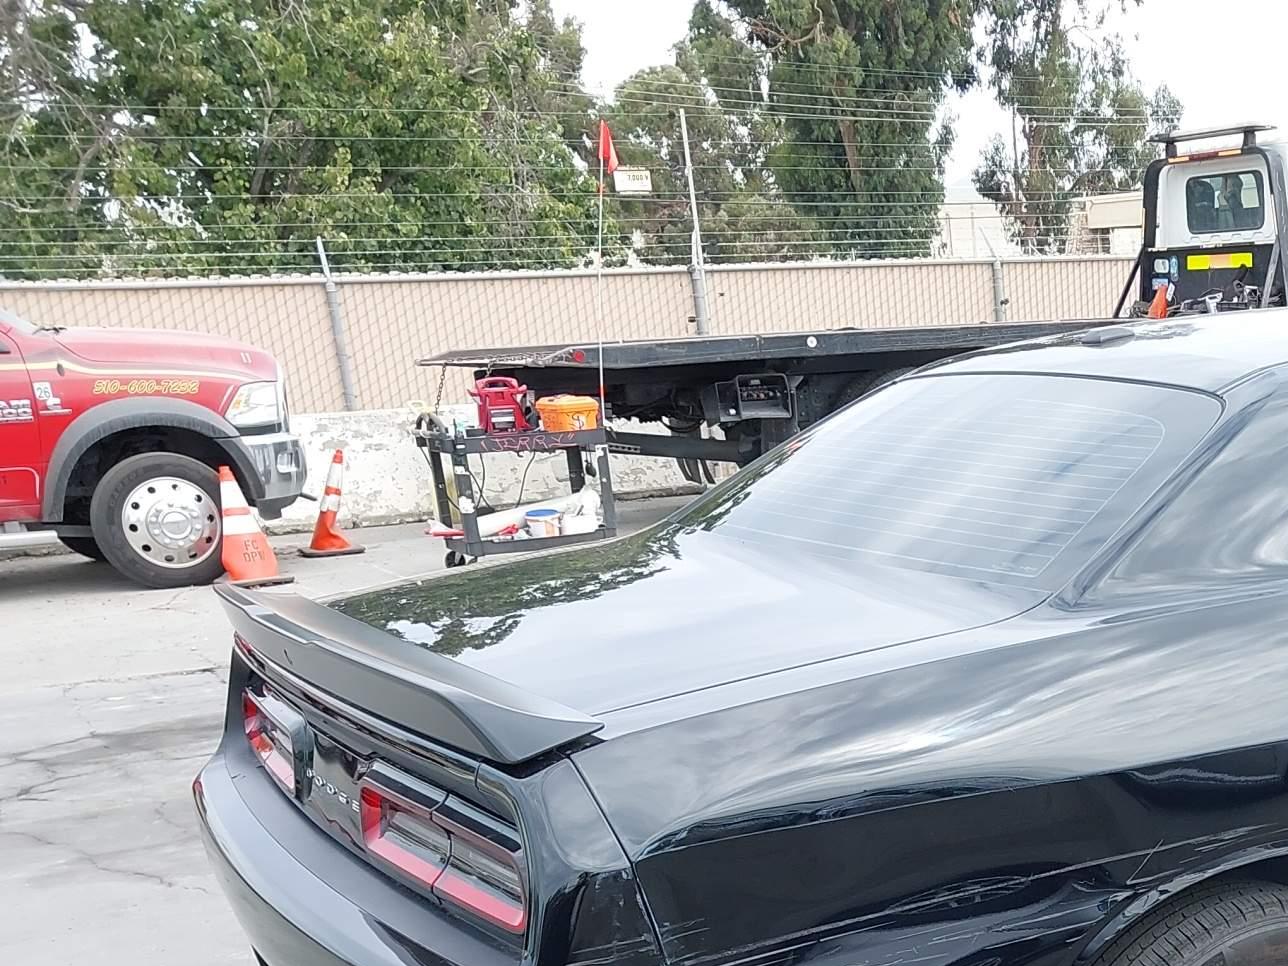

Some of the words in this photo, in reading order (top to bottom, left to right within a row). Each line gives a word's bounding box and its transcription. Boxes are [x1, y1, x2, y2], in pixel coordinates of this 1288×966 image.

[36, 386, 51, 399] 26
[93, 379, 200, 395] 510-600-7232
[306, 768, 360, 813] DODGE
